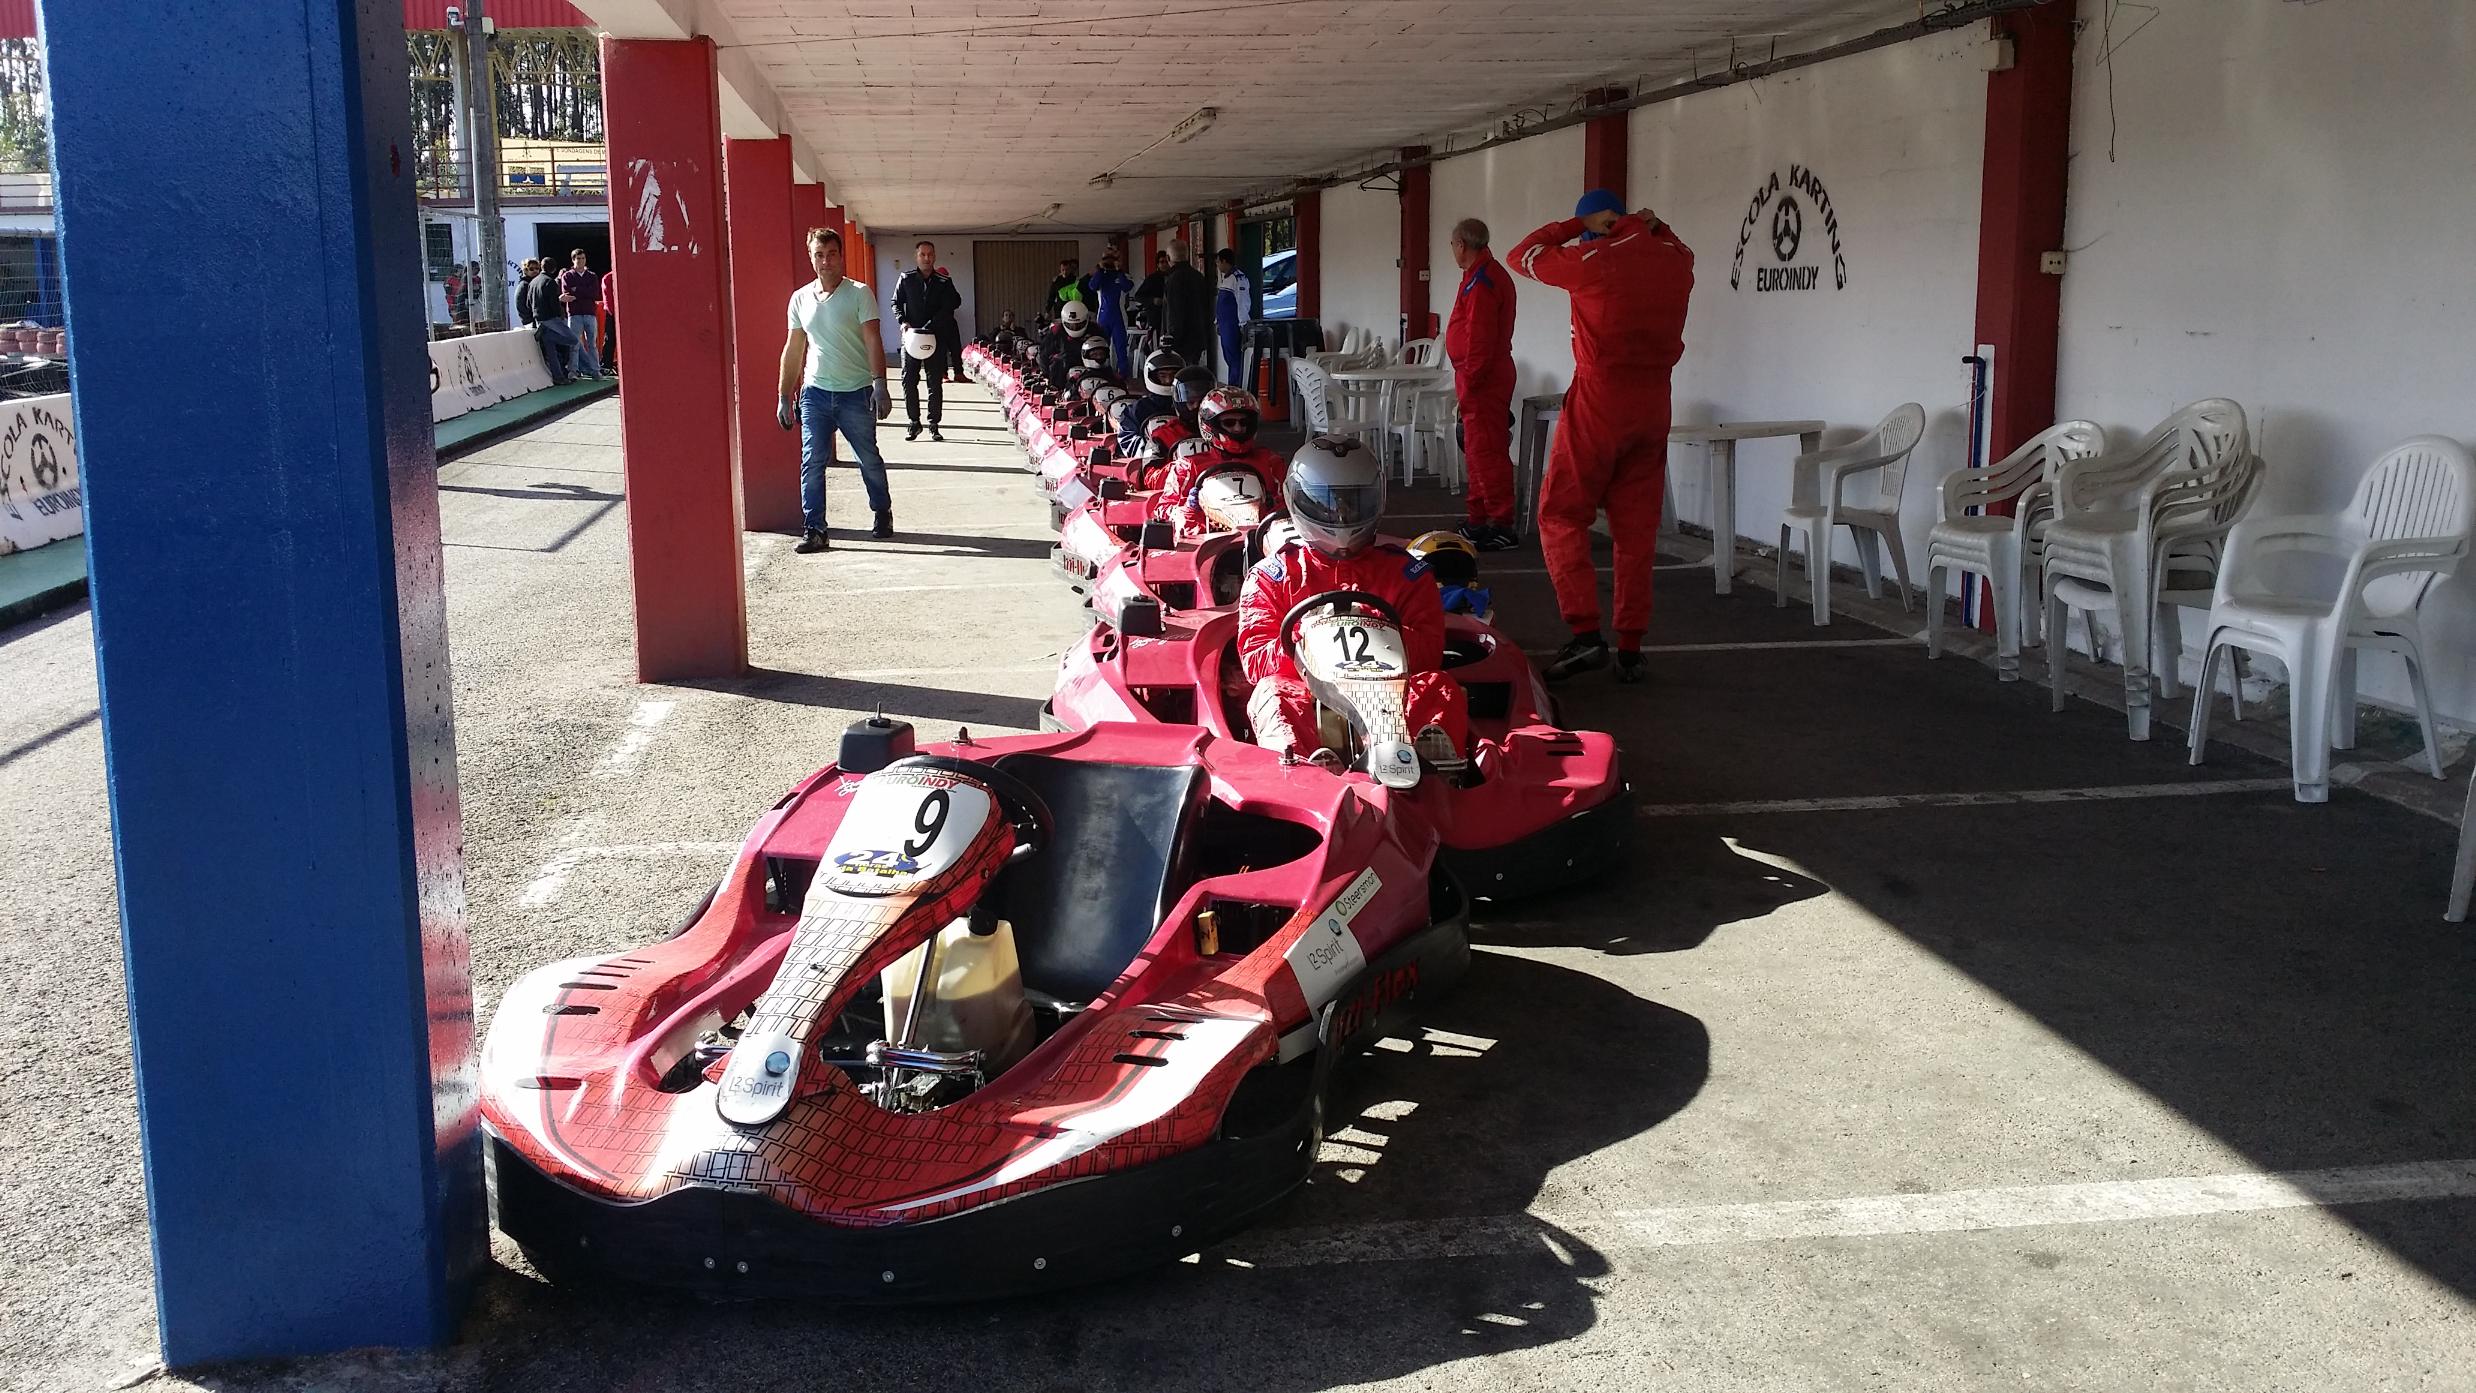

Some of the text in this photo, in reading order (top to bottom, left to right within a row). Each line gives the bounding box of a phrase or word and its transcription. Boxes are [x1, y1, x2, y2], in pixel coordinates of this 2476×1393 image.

[1731, 164, 1847, 291] ESCOLA KARTING
[1757, 266, 1819, 292] EUROINDY
[1107, 390, 1115, 401] 6
[1232, 478, 1244, 496] 7
[1333, 626, 1376, 662] 12
[876, 775, 959, 789] UROINDY
[904, 789, 951, 858] 9
